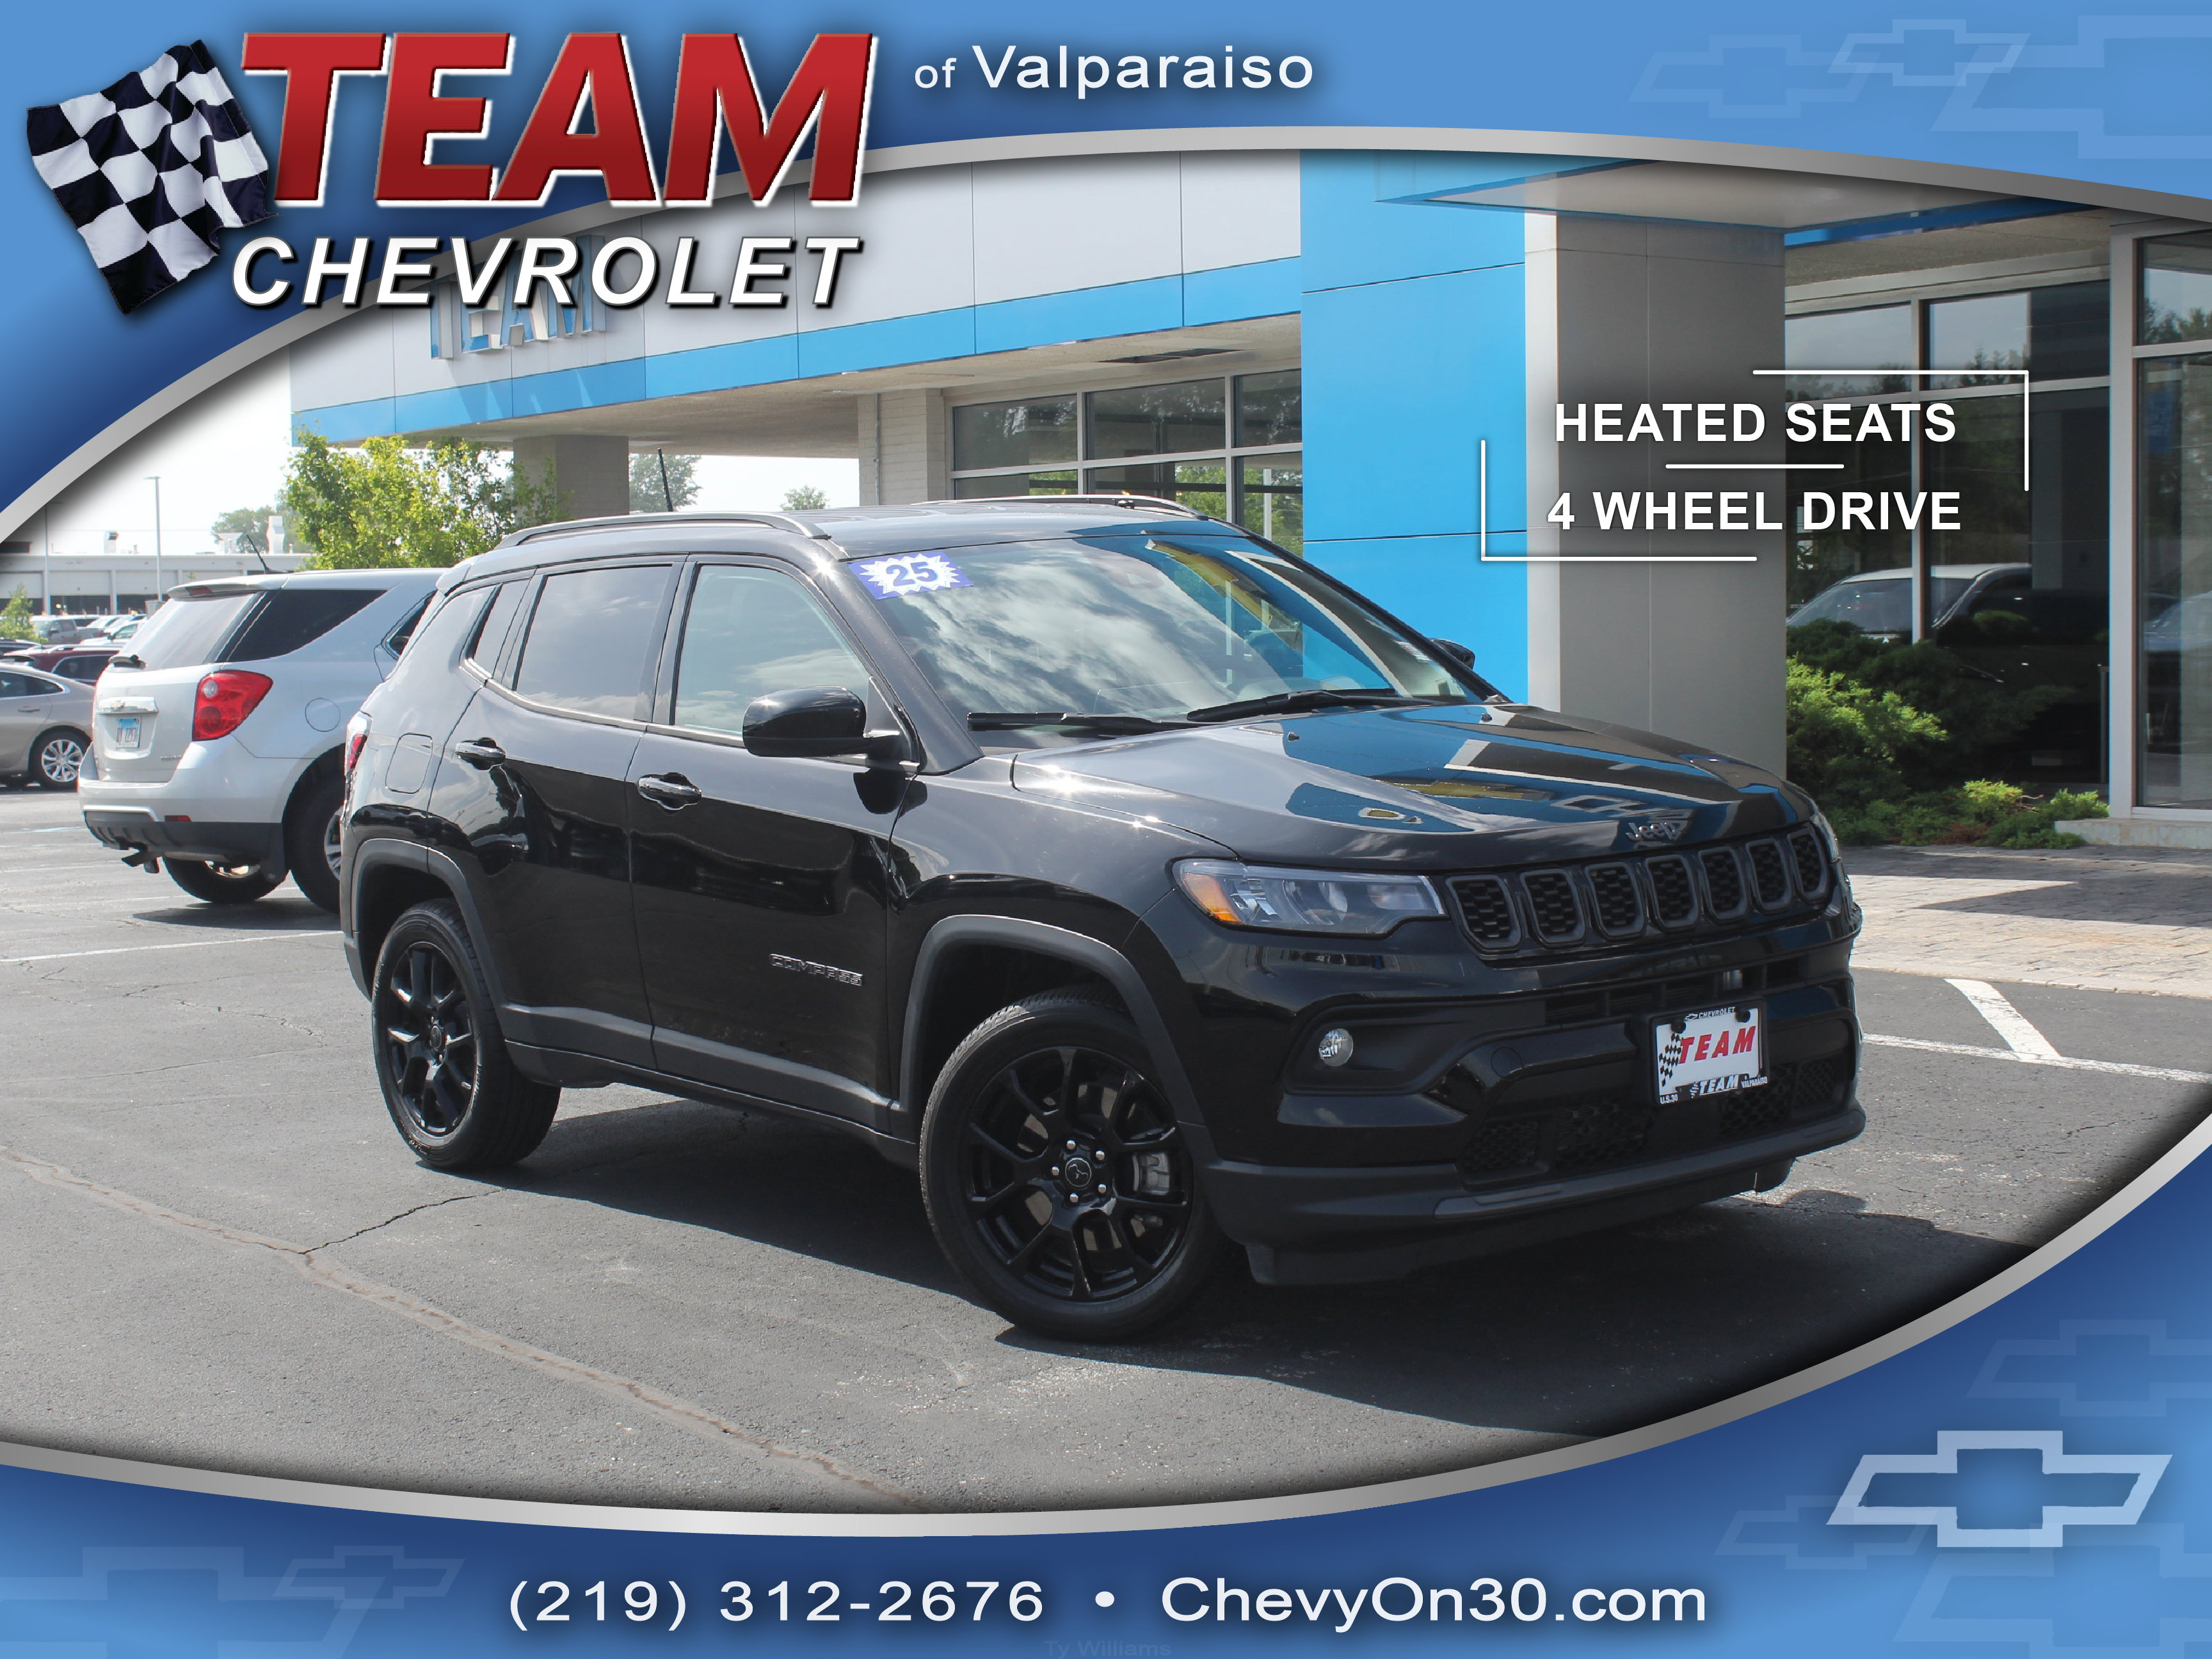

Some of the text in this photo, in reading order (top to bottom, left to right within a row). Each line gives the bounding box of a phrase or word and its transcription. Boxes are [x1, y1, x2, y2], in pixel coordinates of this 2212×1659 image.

[886, 561, 938, 587] 25
[1698, 1006, 1736, 1020] CHEVROLET
[1678, 1025, 1756, 1064] TEAM
[1699, 1075, 1740, 1094] TEAM
